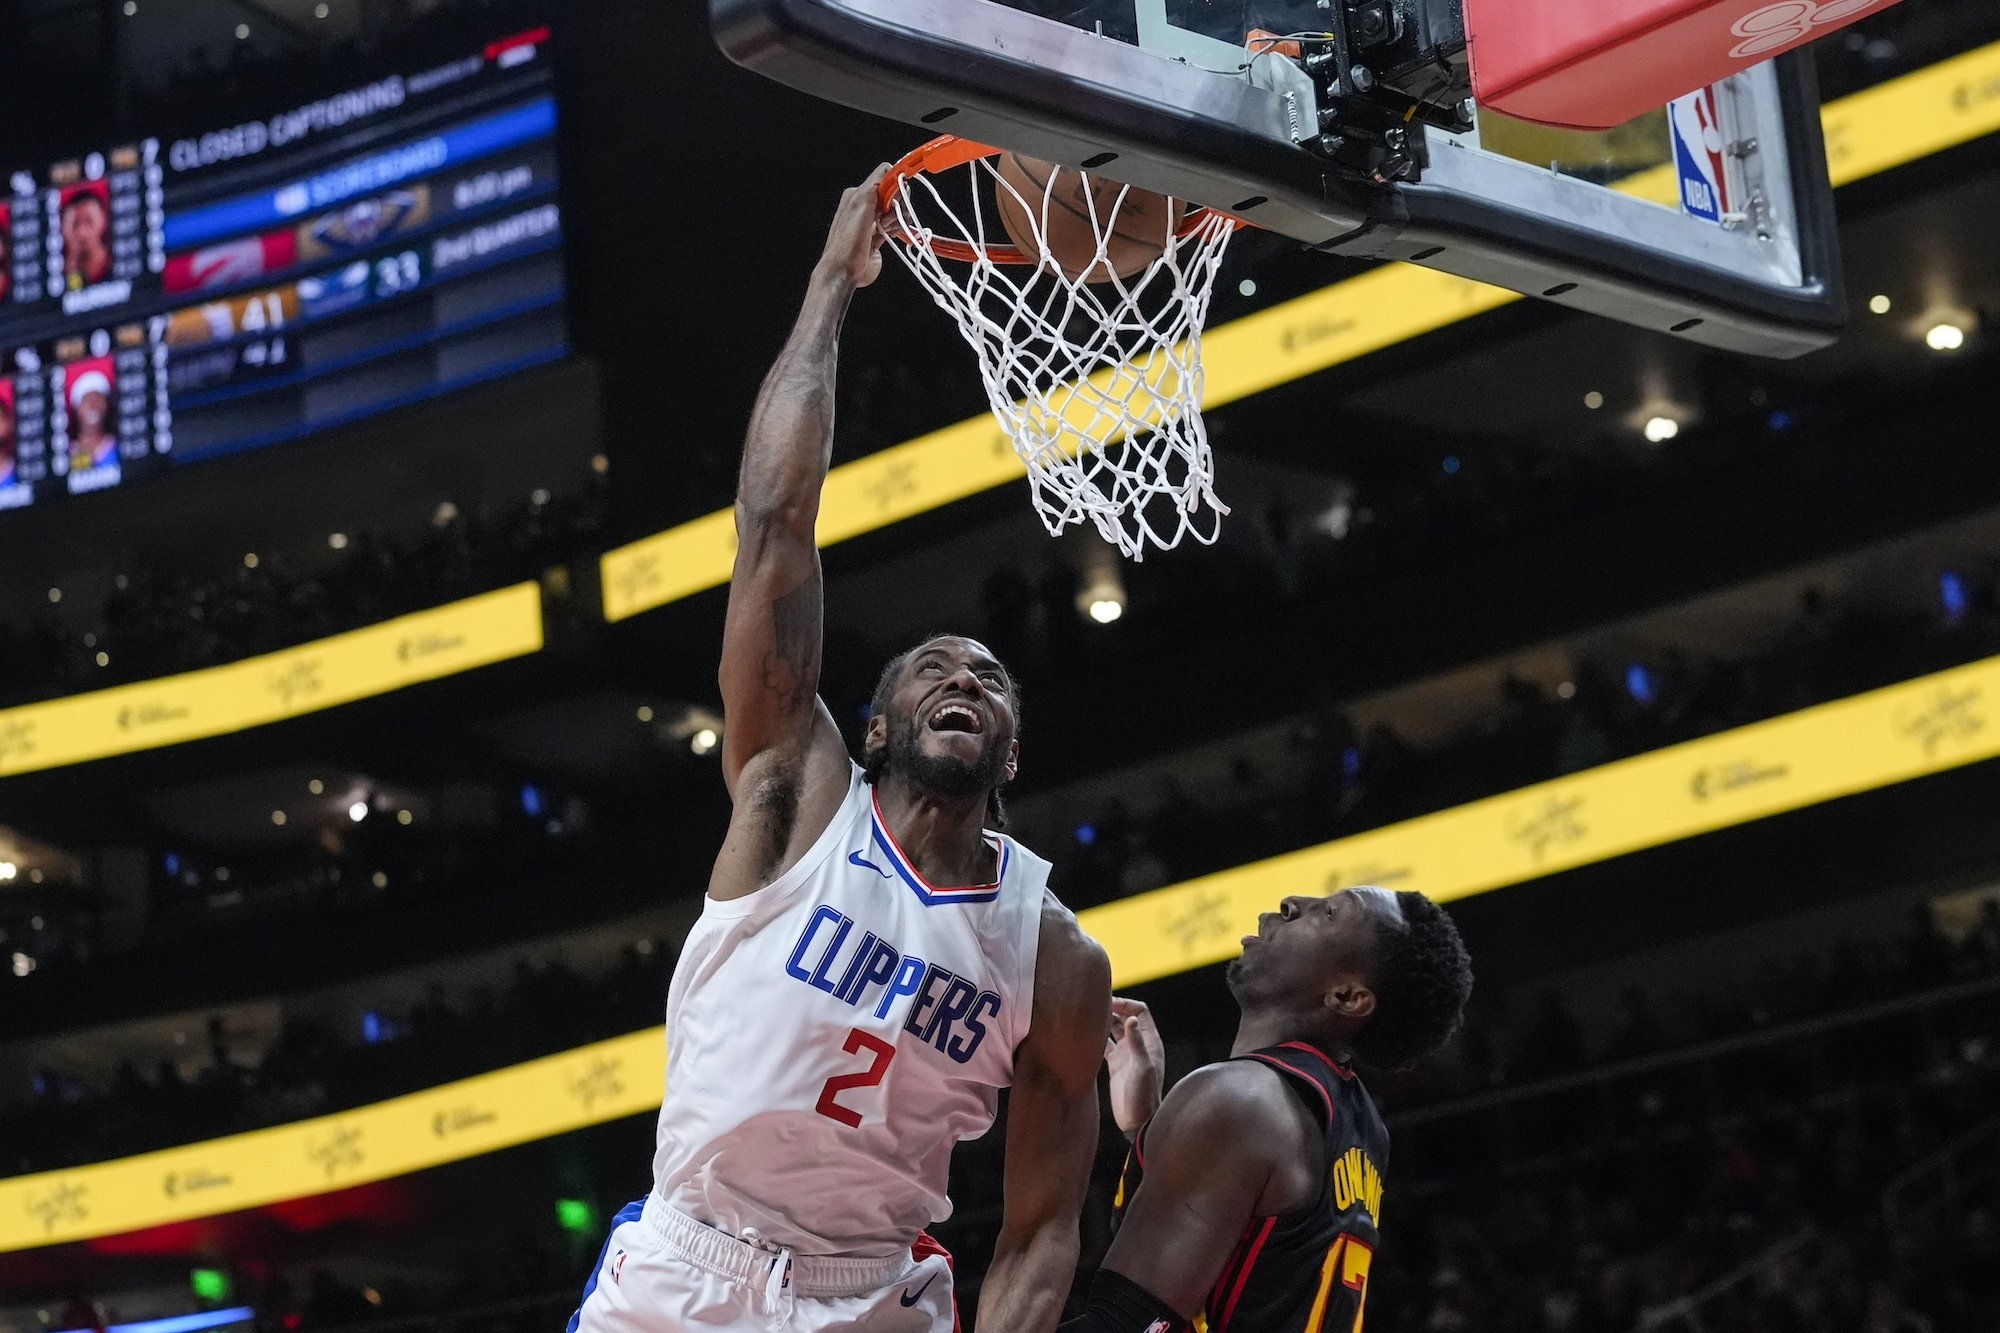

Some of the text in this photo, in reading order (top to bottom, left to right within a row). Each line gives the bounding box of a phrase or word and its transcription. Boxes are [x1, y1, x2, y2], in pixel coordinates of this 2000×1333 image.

[169, 119, 268, 172] CLOSED
[268, 74, 406, 147] CAPTIONING
[1684, 177, 1714, 213] NBA
[472, 203, 560, 255] QUARTER
[376, 250, 421, 297] 33
[241, 292, 284, 333] 41
[785, 904, 1001, 1064] CLIPPERS
[815, 1027, 896, 1129] 2
